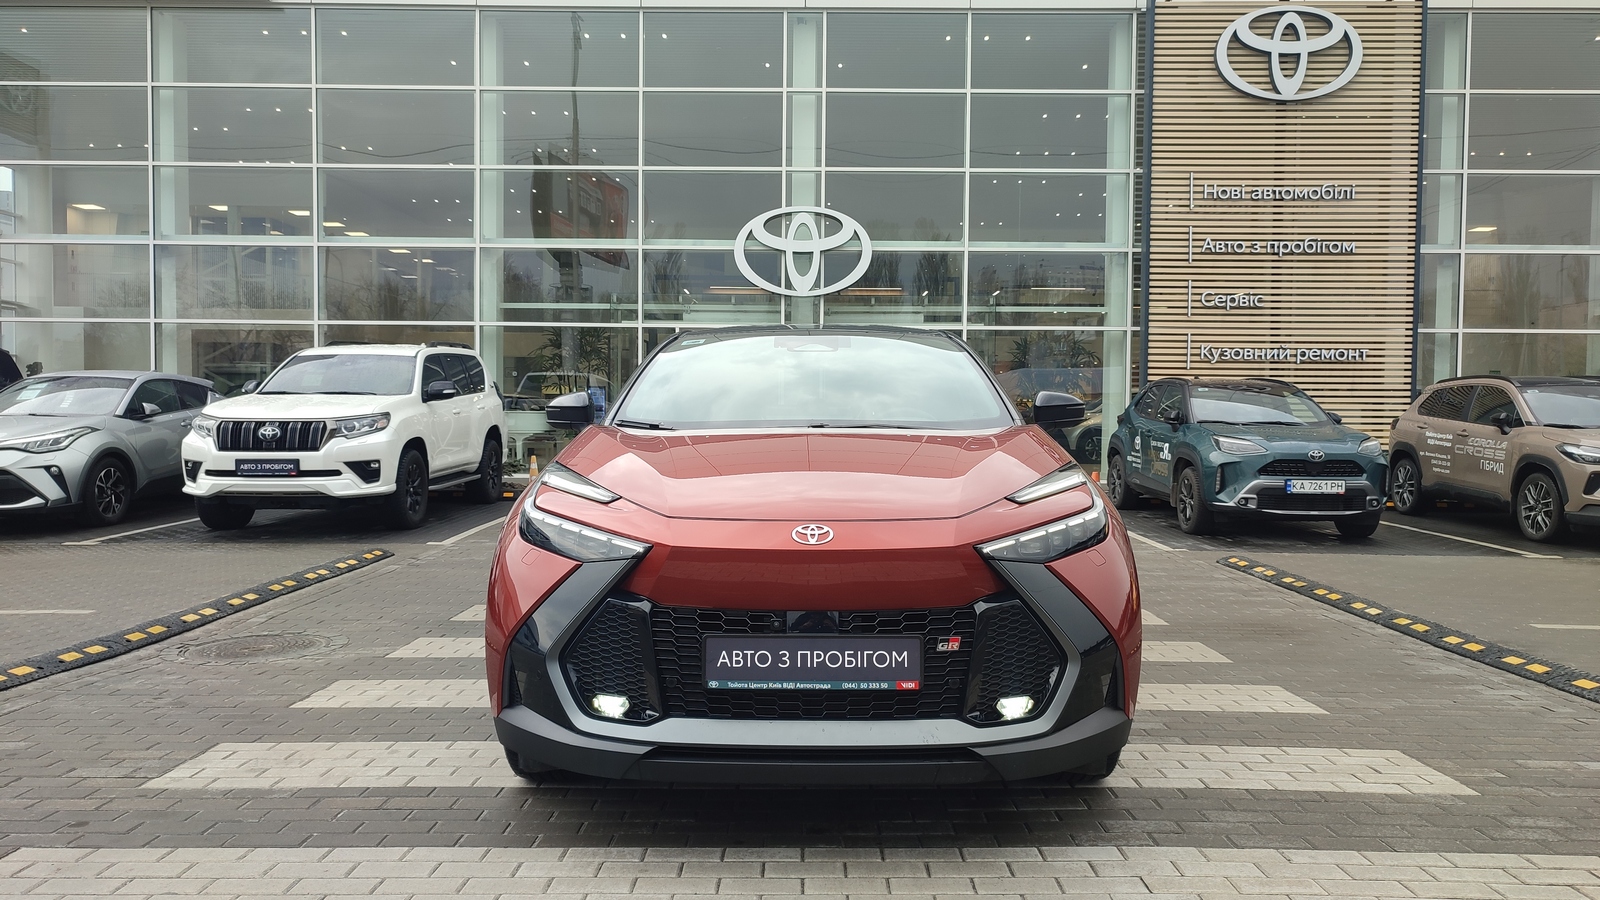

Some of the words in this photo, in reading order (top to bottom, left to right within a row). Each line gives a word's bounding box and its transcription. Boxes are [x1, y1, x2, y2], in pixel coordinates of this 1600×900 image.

[1202, 183, 1246, 200] Нові
[1251, 183, 1356, 200] автомобілі
[1201, 237, 1246, 253] Авто
[1250, 241, 1261, 253] з
[1266, 237, 1356, 257] пробігом
[1201, 291, 1265, 311] Сервіс
[1200, 344, 1291, 364] Кузовний
[1296, 347, 1369, 364] ремонт
[1468, 437, 1508, 449] COROLLA
[1454, 444, 1506, 460] CROSS
[1308, 481, 1328, 491] 7261
[717, 650, 772, 668] АВТО
[778, 650, 790, 668] З
[797, 650, 908, 668] ПРОБІГОМ
[796, 682, 831, 690] Автострада
[842, 682, 858, 690] (044)
